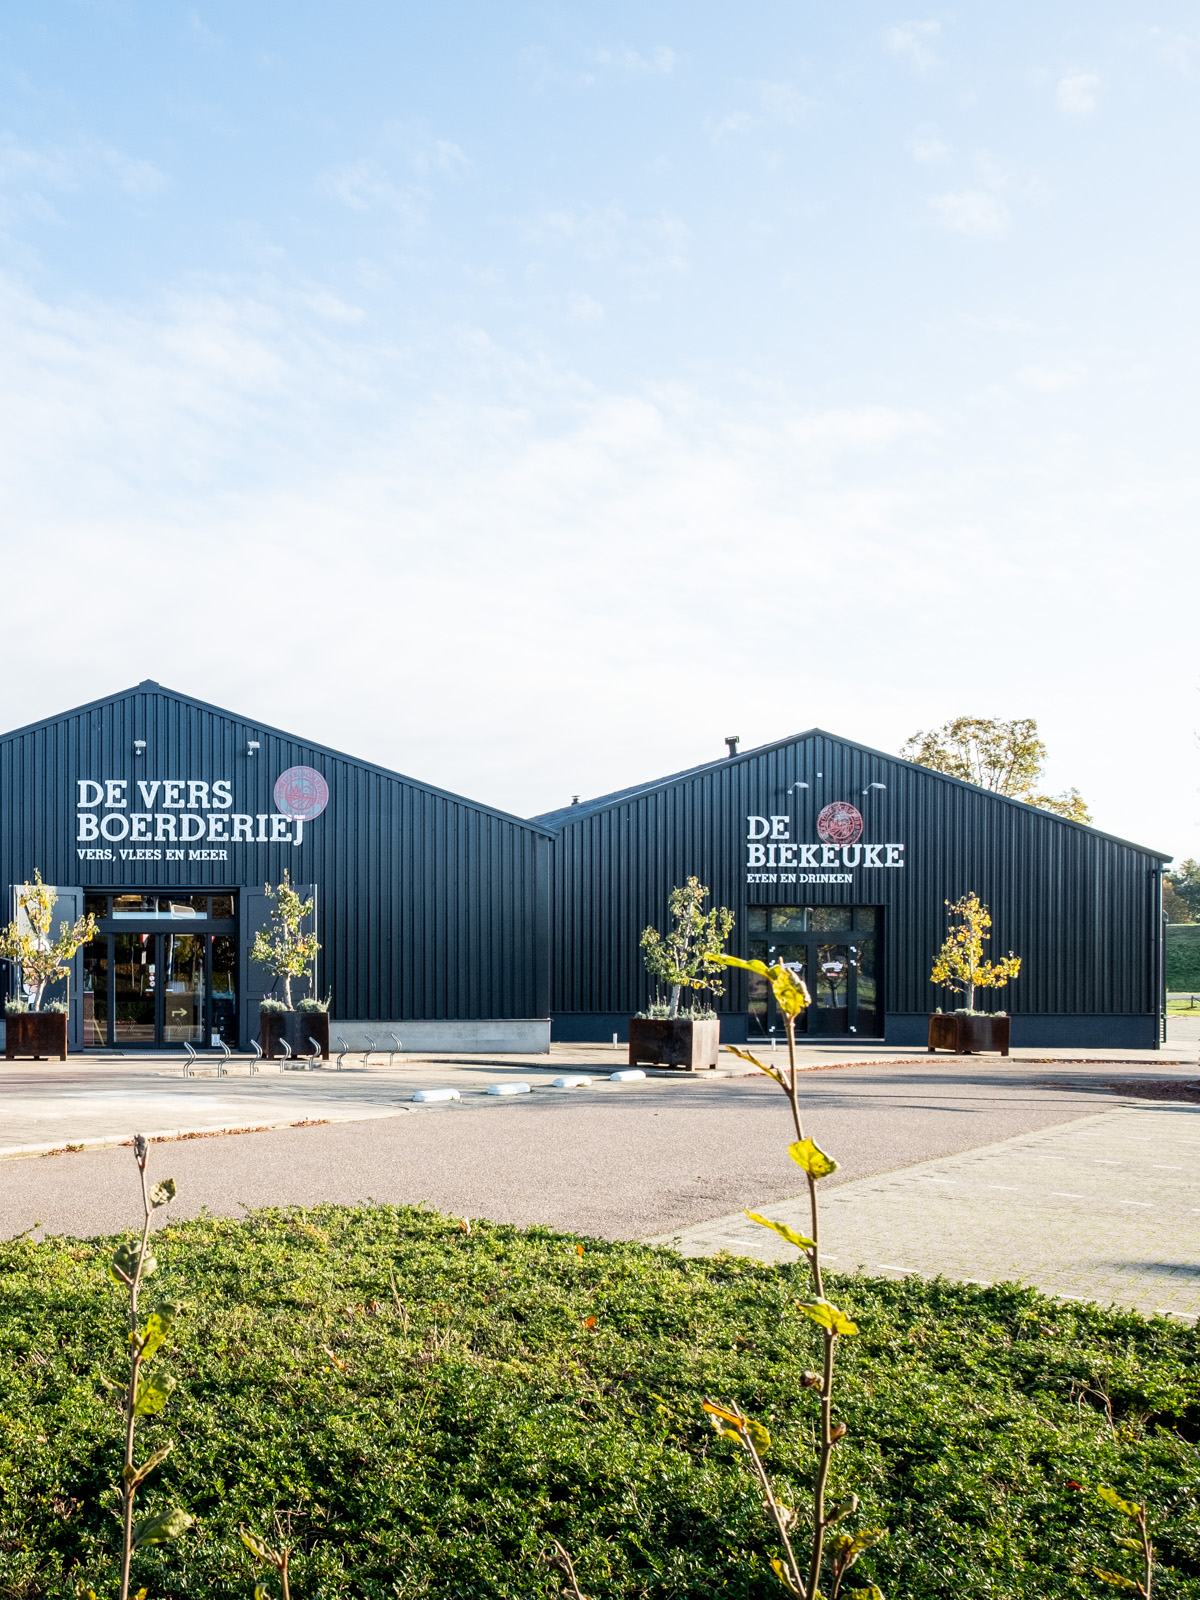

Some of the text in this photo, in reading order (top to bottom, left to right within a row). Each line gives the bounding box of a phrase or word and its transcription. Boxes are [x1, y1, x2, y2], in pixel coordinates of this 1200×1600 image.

[77, 780, 233, 809] DE VERS
[77, 813, 306, 846] BOERDERIEJ
[747, 816, 790, 839] DE
[77, 848, 228, 862] VERS, VLEES EN MEER
[747, 843, 904, 867] BIEKEUKE
[747, 873, 853, 884] ETEN EN DRINKEN
